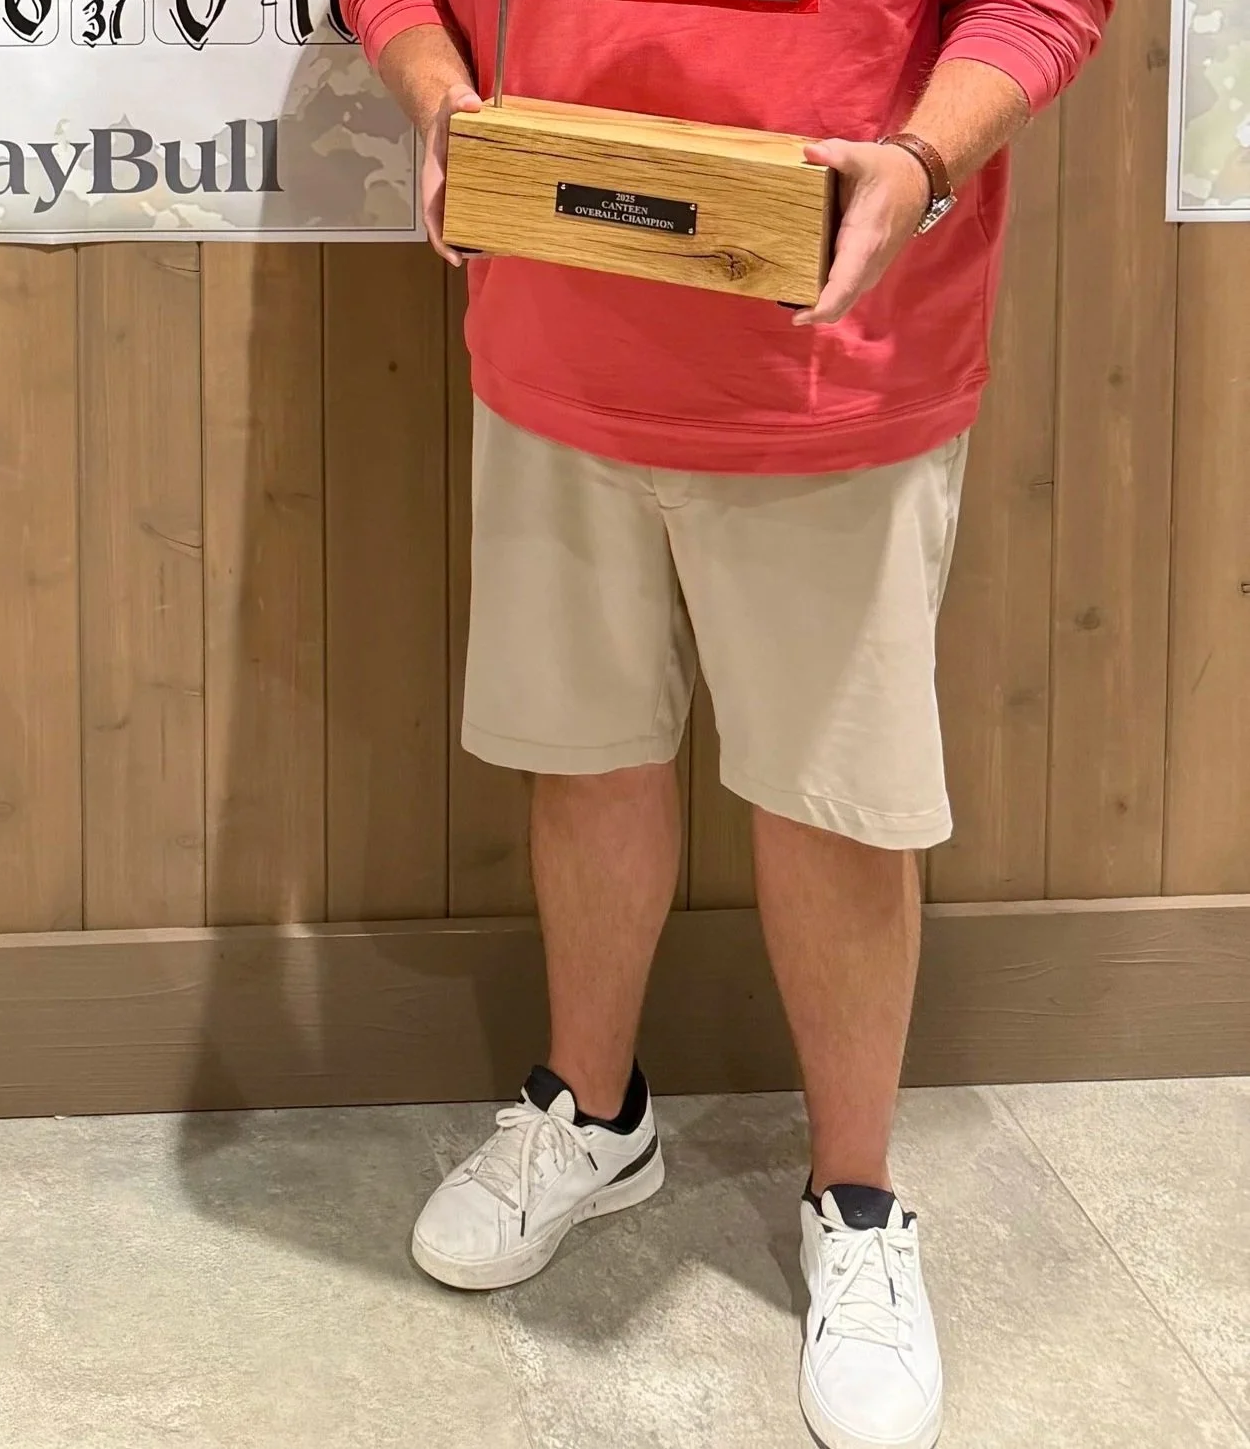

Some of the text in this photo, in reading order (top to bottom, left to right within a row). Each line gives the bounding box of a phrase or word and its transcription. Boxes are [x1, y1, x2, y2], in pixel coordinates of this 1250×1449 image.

[616, 193, 635, 202] 2025
[601, 200, 648, 214] CANTEEN
[575, 206, 674, 229] OVERALL CHAMPION
